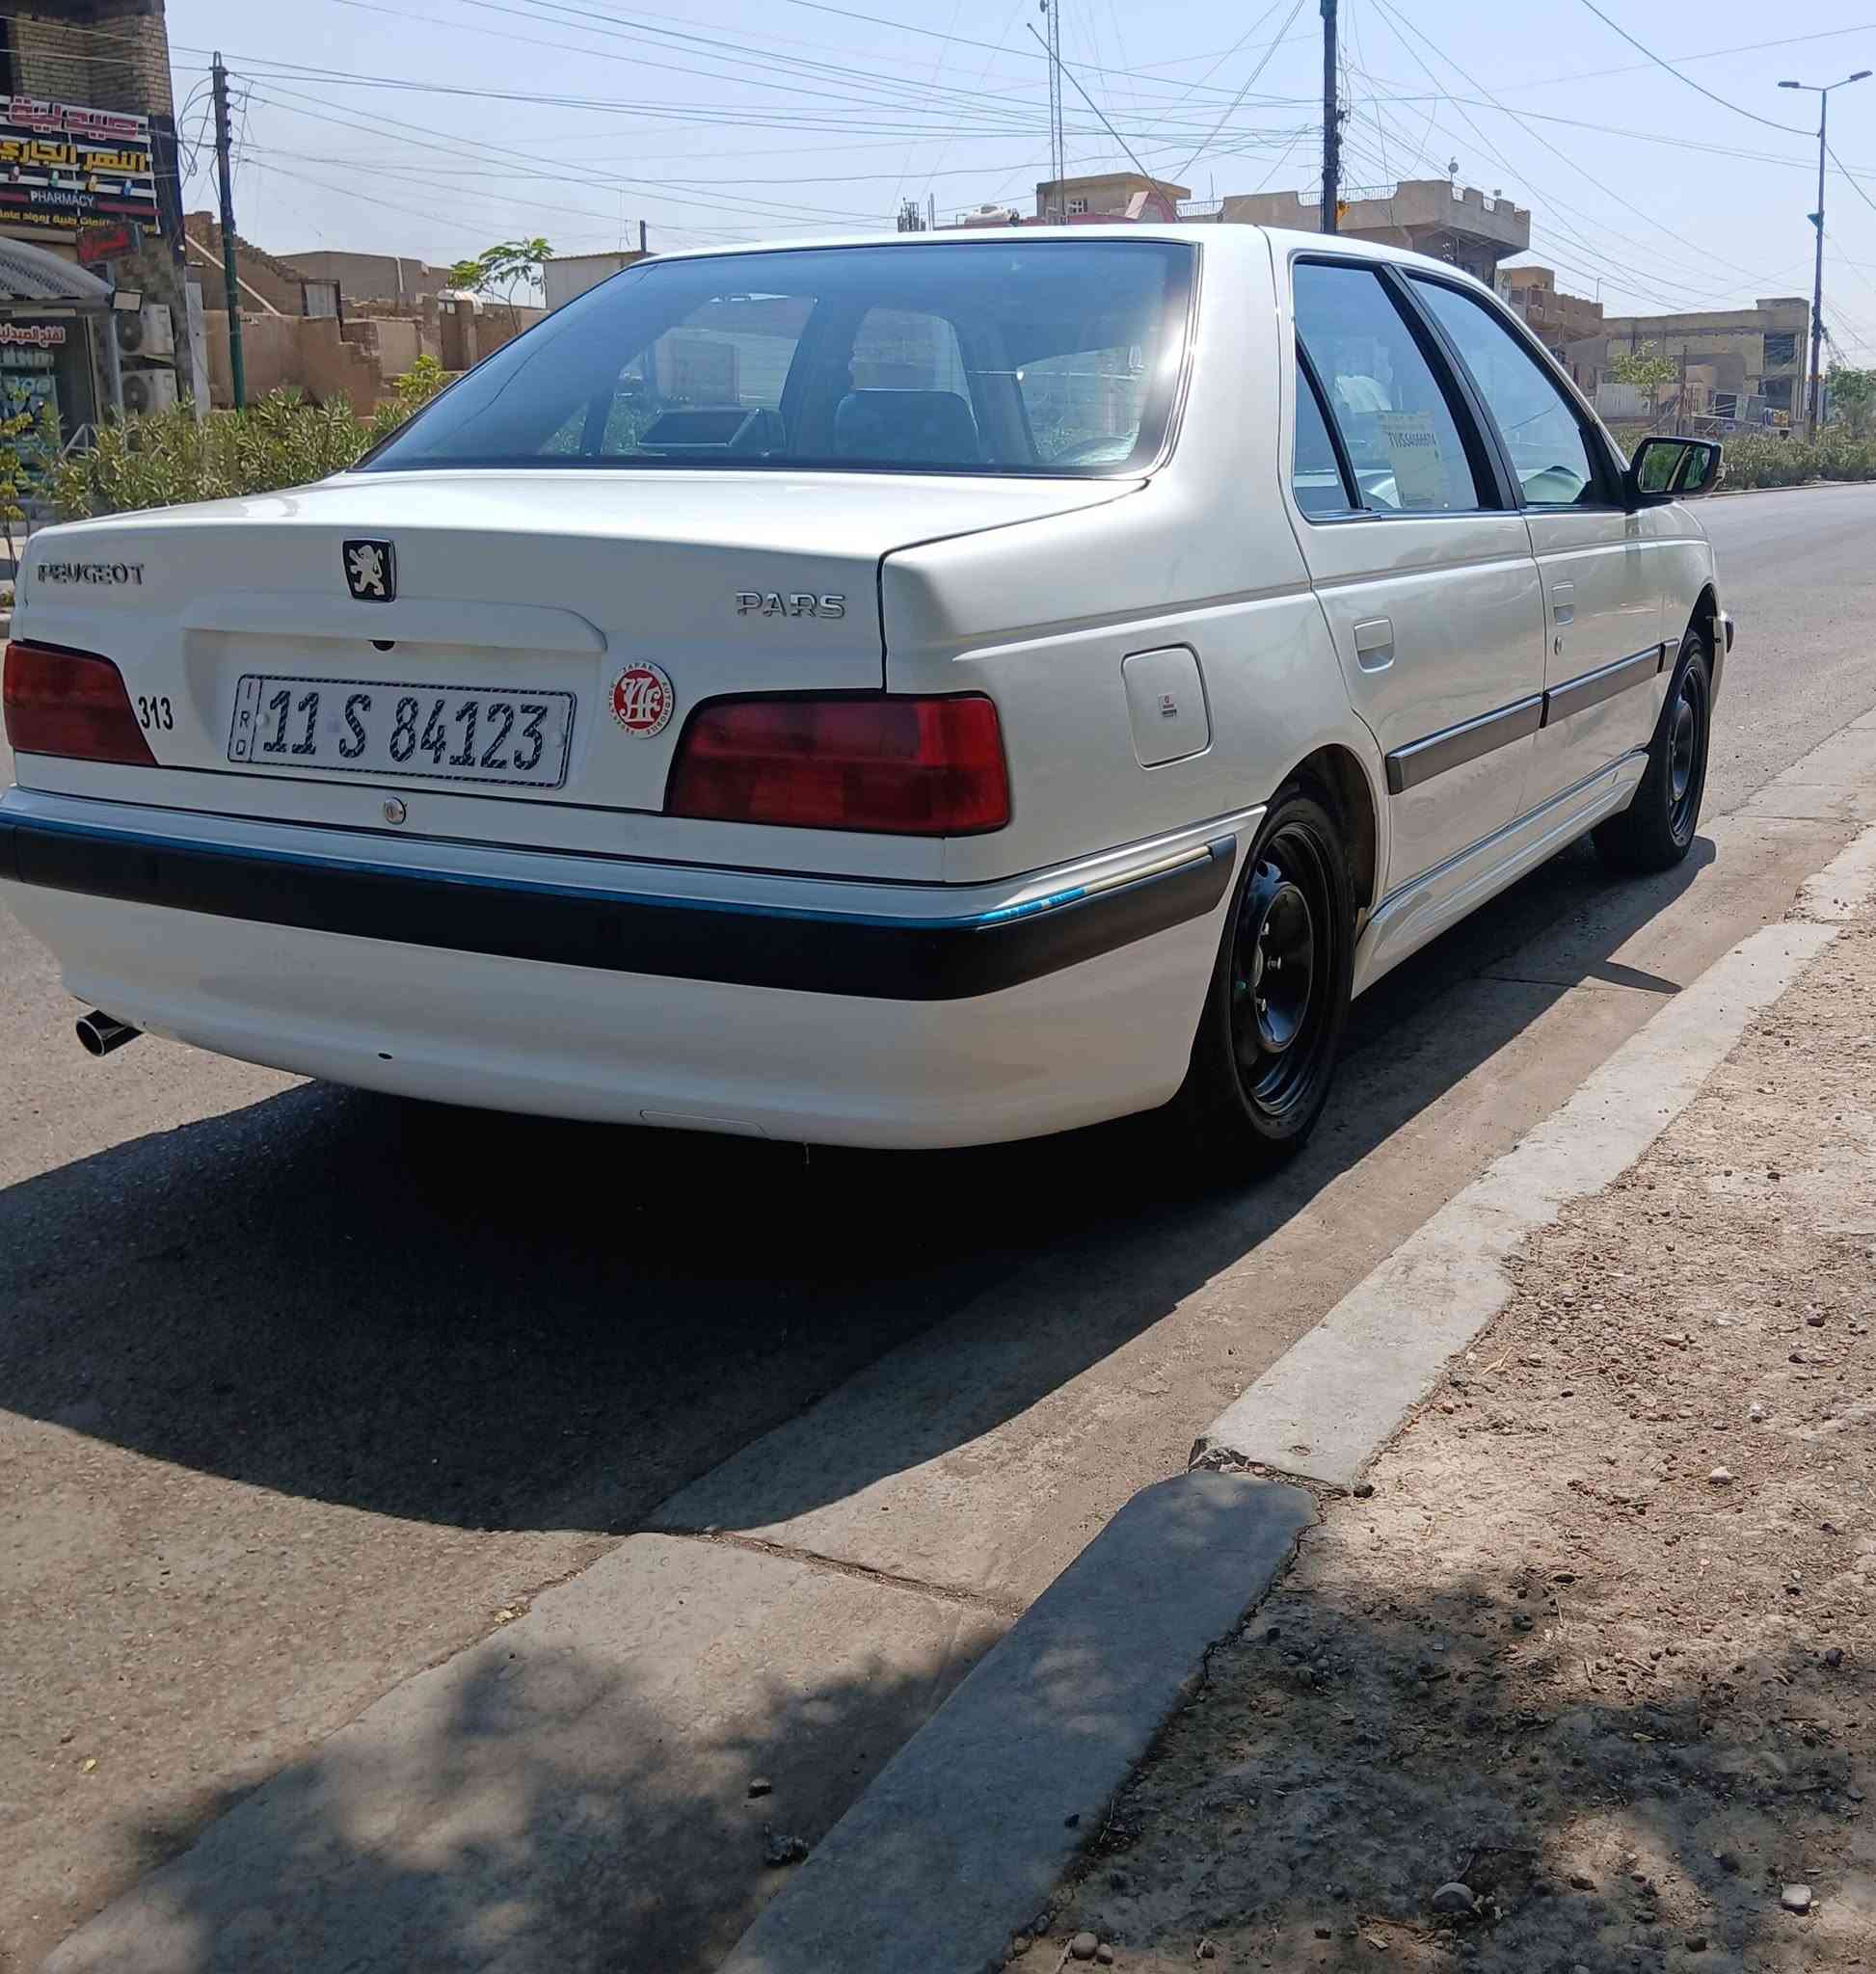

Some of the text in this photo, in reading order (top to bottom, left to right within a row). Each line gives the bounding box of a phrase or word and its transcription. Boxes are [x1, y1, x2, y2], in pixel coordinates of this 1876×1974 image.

[30, 190, 94, 207] PHARMACY
[38, 562, 145, 585] PEUGEOT
[735, 591, 846, 619] PARS
[138, 696, 174, 731] 313
[263, 690, 548, 771] 11 S 84123
